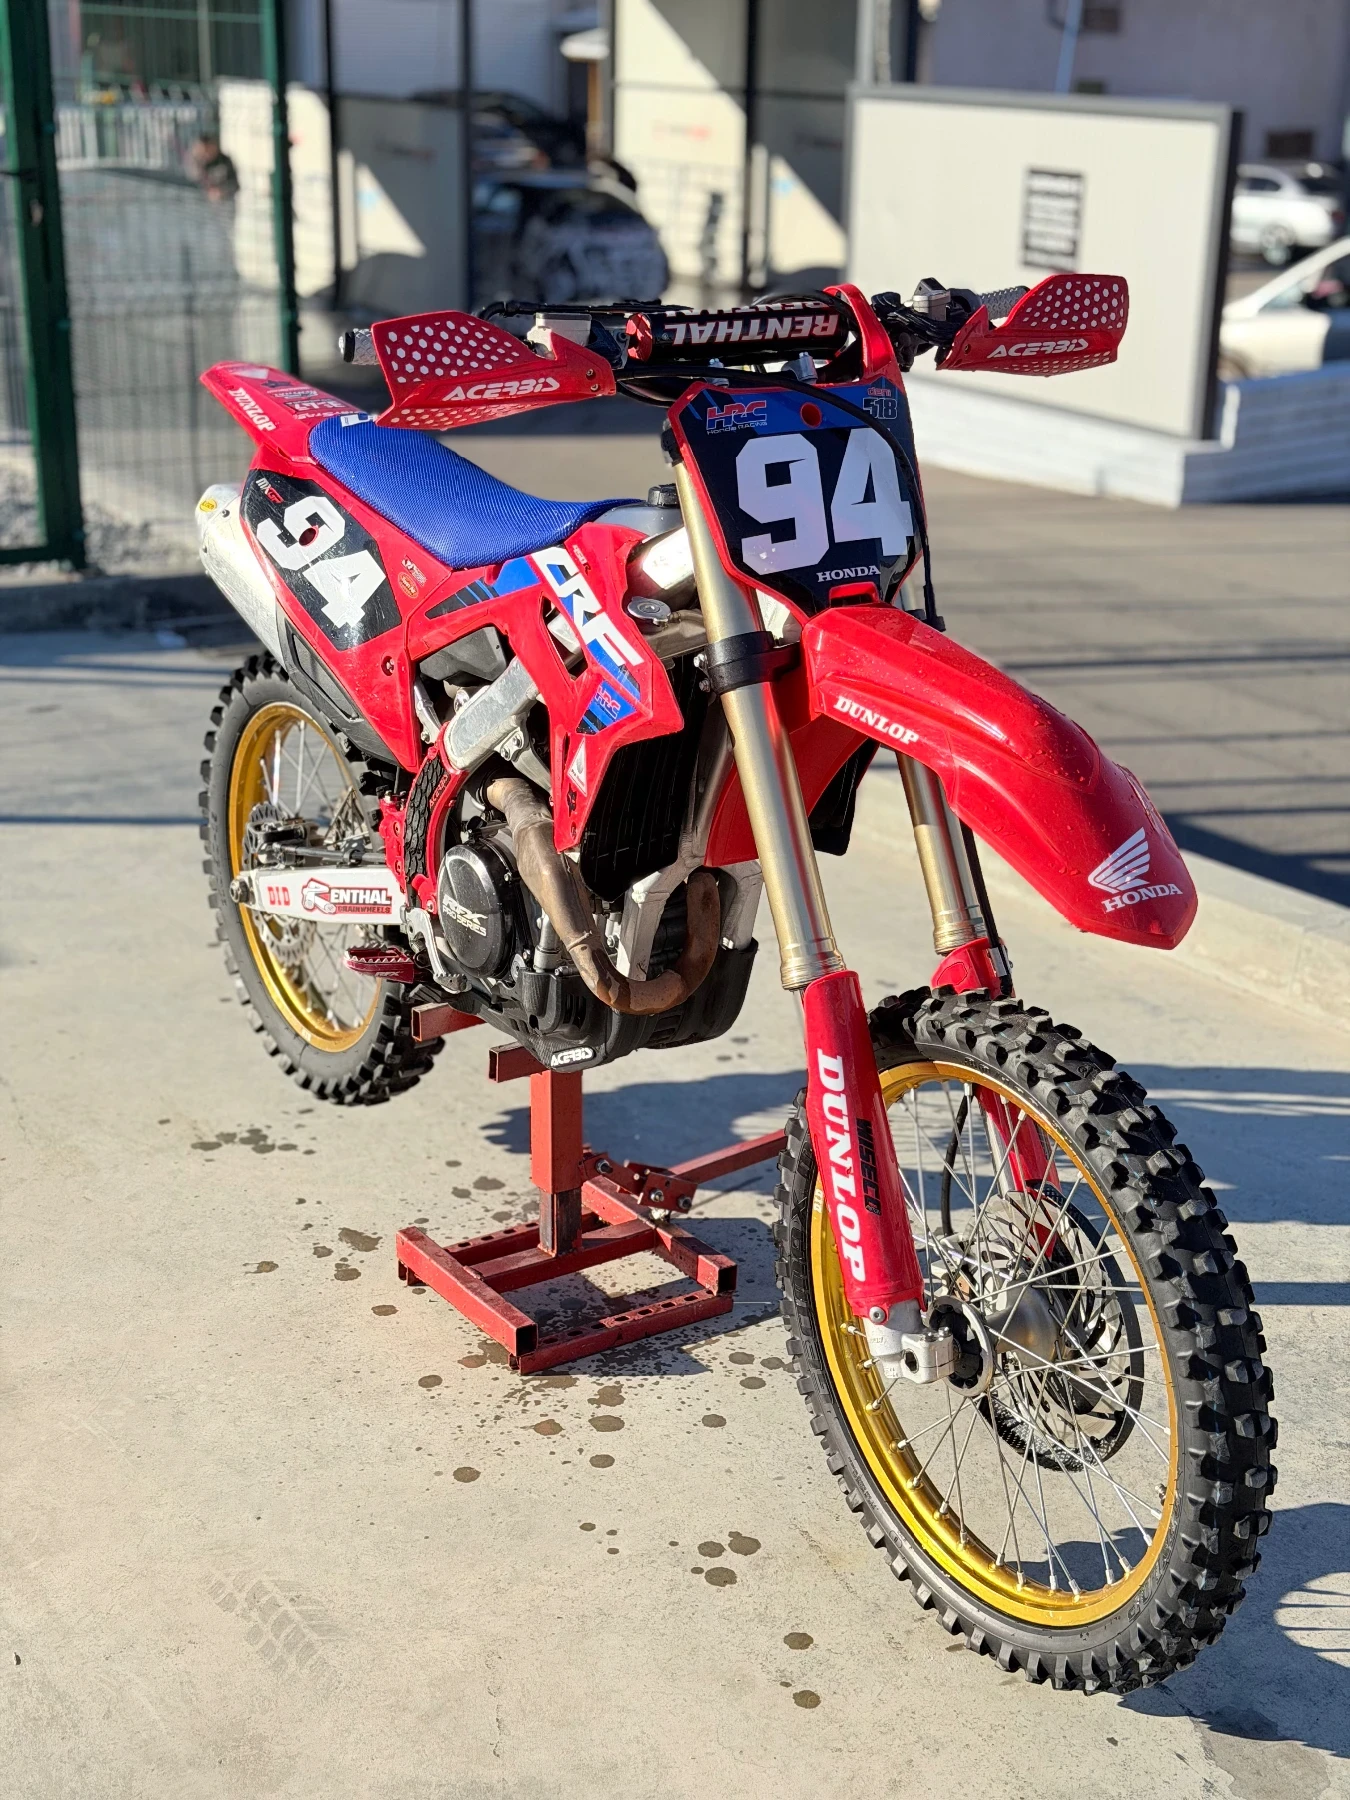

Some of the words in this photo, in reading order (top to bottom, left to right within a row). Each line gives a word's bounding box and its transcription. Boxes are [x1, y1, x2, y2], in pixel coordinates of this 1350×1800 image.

[664, 315, 839, 346] RENTHAL
[986, 338, 1090, 358] ACERBIS
[441, 376, 561, 402] ACERBIS
[229, 388, 276, 432] DUNLOP
[706, 400, 767, 430] HRC
[863, 397, 898, 420] 518
[736, 427, 914, 575] 94
[257, 495, 386, 630] 94
[816, 565, 881, 582] HONDA
[531, 546, 644, 667] CRF
[833, 695, 919, 747] DUNLOP
[267, 886, 291, 905] DID
[442, 894, 488, 922] RFX
[1102, 882, 1183, 913] HONDA
[442, 905, 457, 919] PRO
[456, 912, 488, 937] SERIES
[551, 1046, 593, 1067] ACERBIS
[817, 1047, 867, 1282] DUNLOP
[856, 1116, 881, 1215] WISECO
